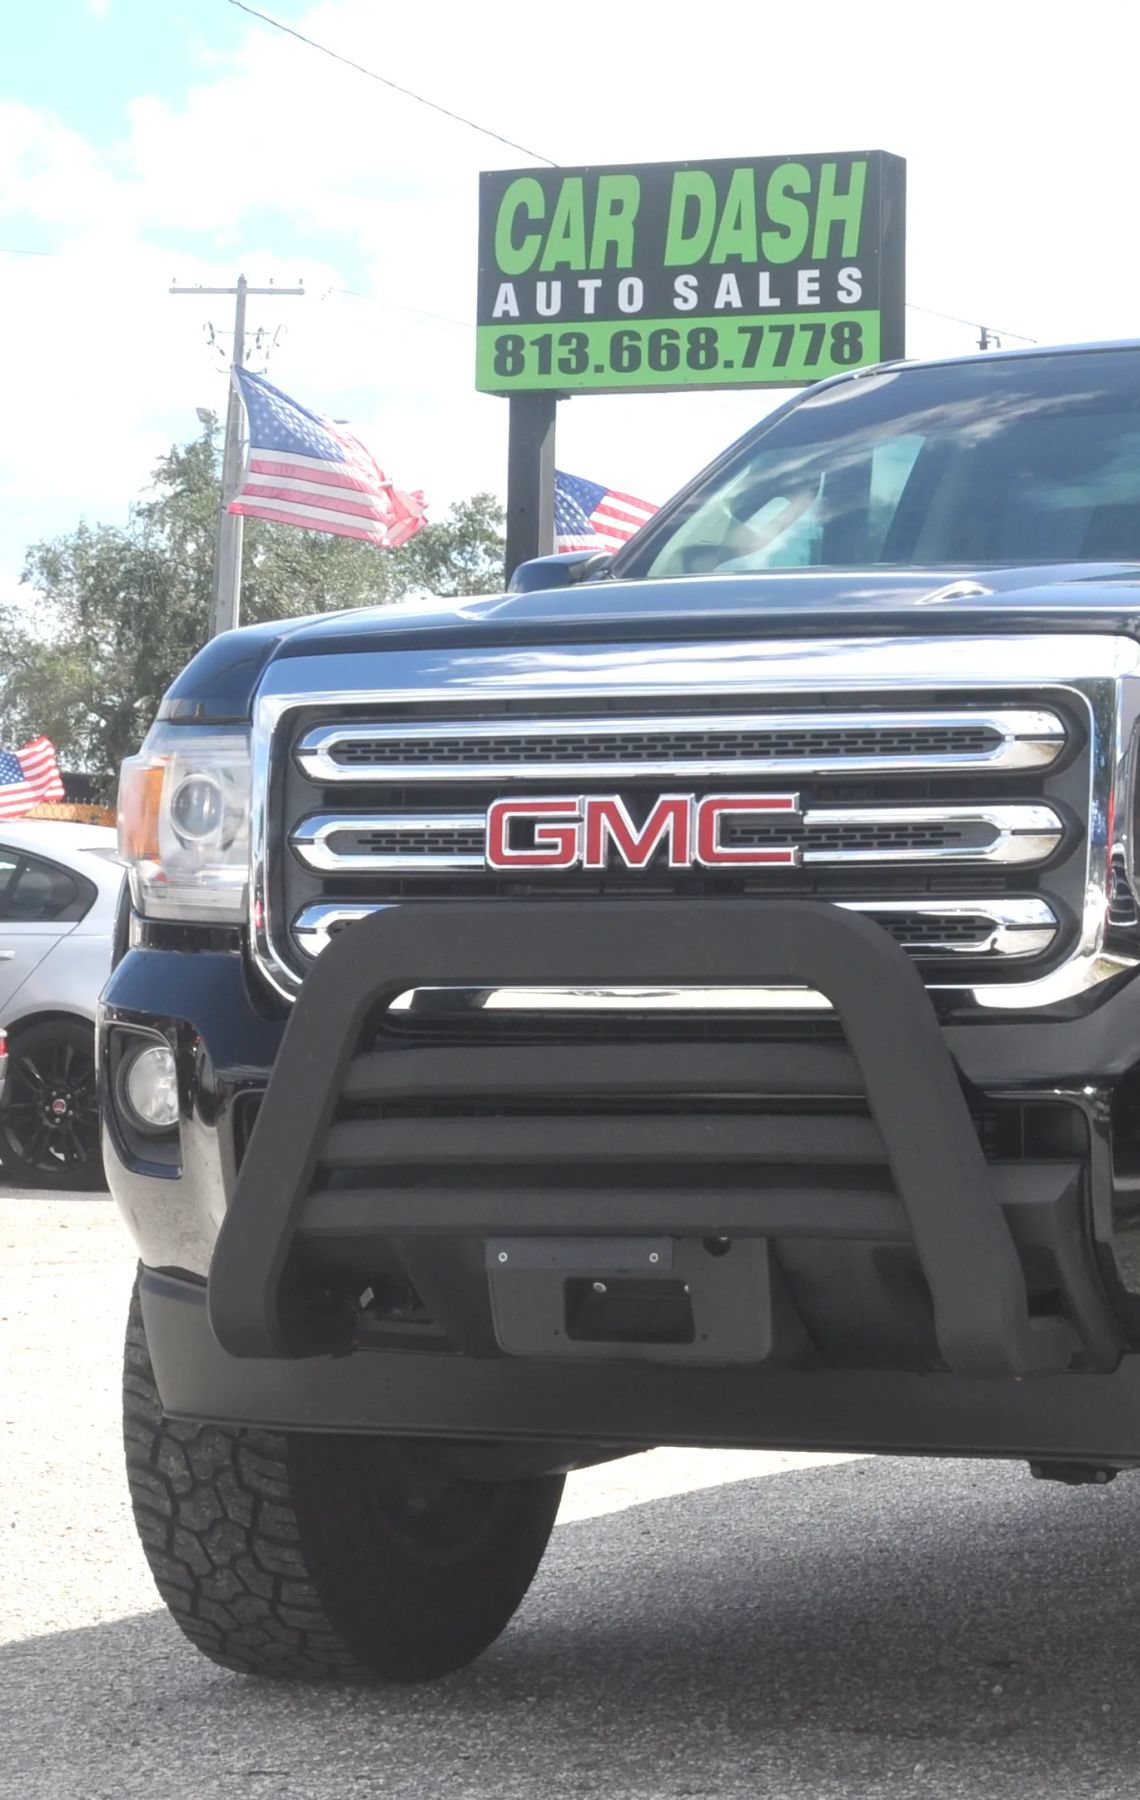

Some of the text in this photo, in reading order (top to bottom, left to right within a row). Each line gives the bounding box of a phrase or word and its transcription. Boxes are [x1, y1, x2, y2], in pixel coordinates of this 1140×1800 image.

[494, 161, 867, 275] CAR DASH
[492, 266, 863, 317] AUTO SALES
[493, 320, 864, 377] 813.668.7778
[486, 792, 799, 869] GMC
